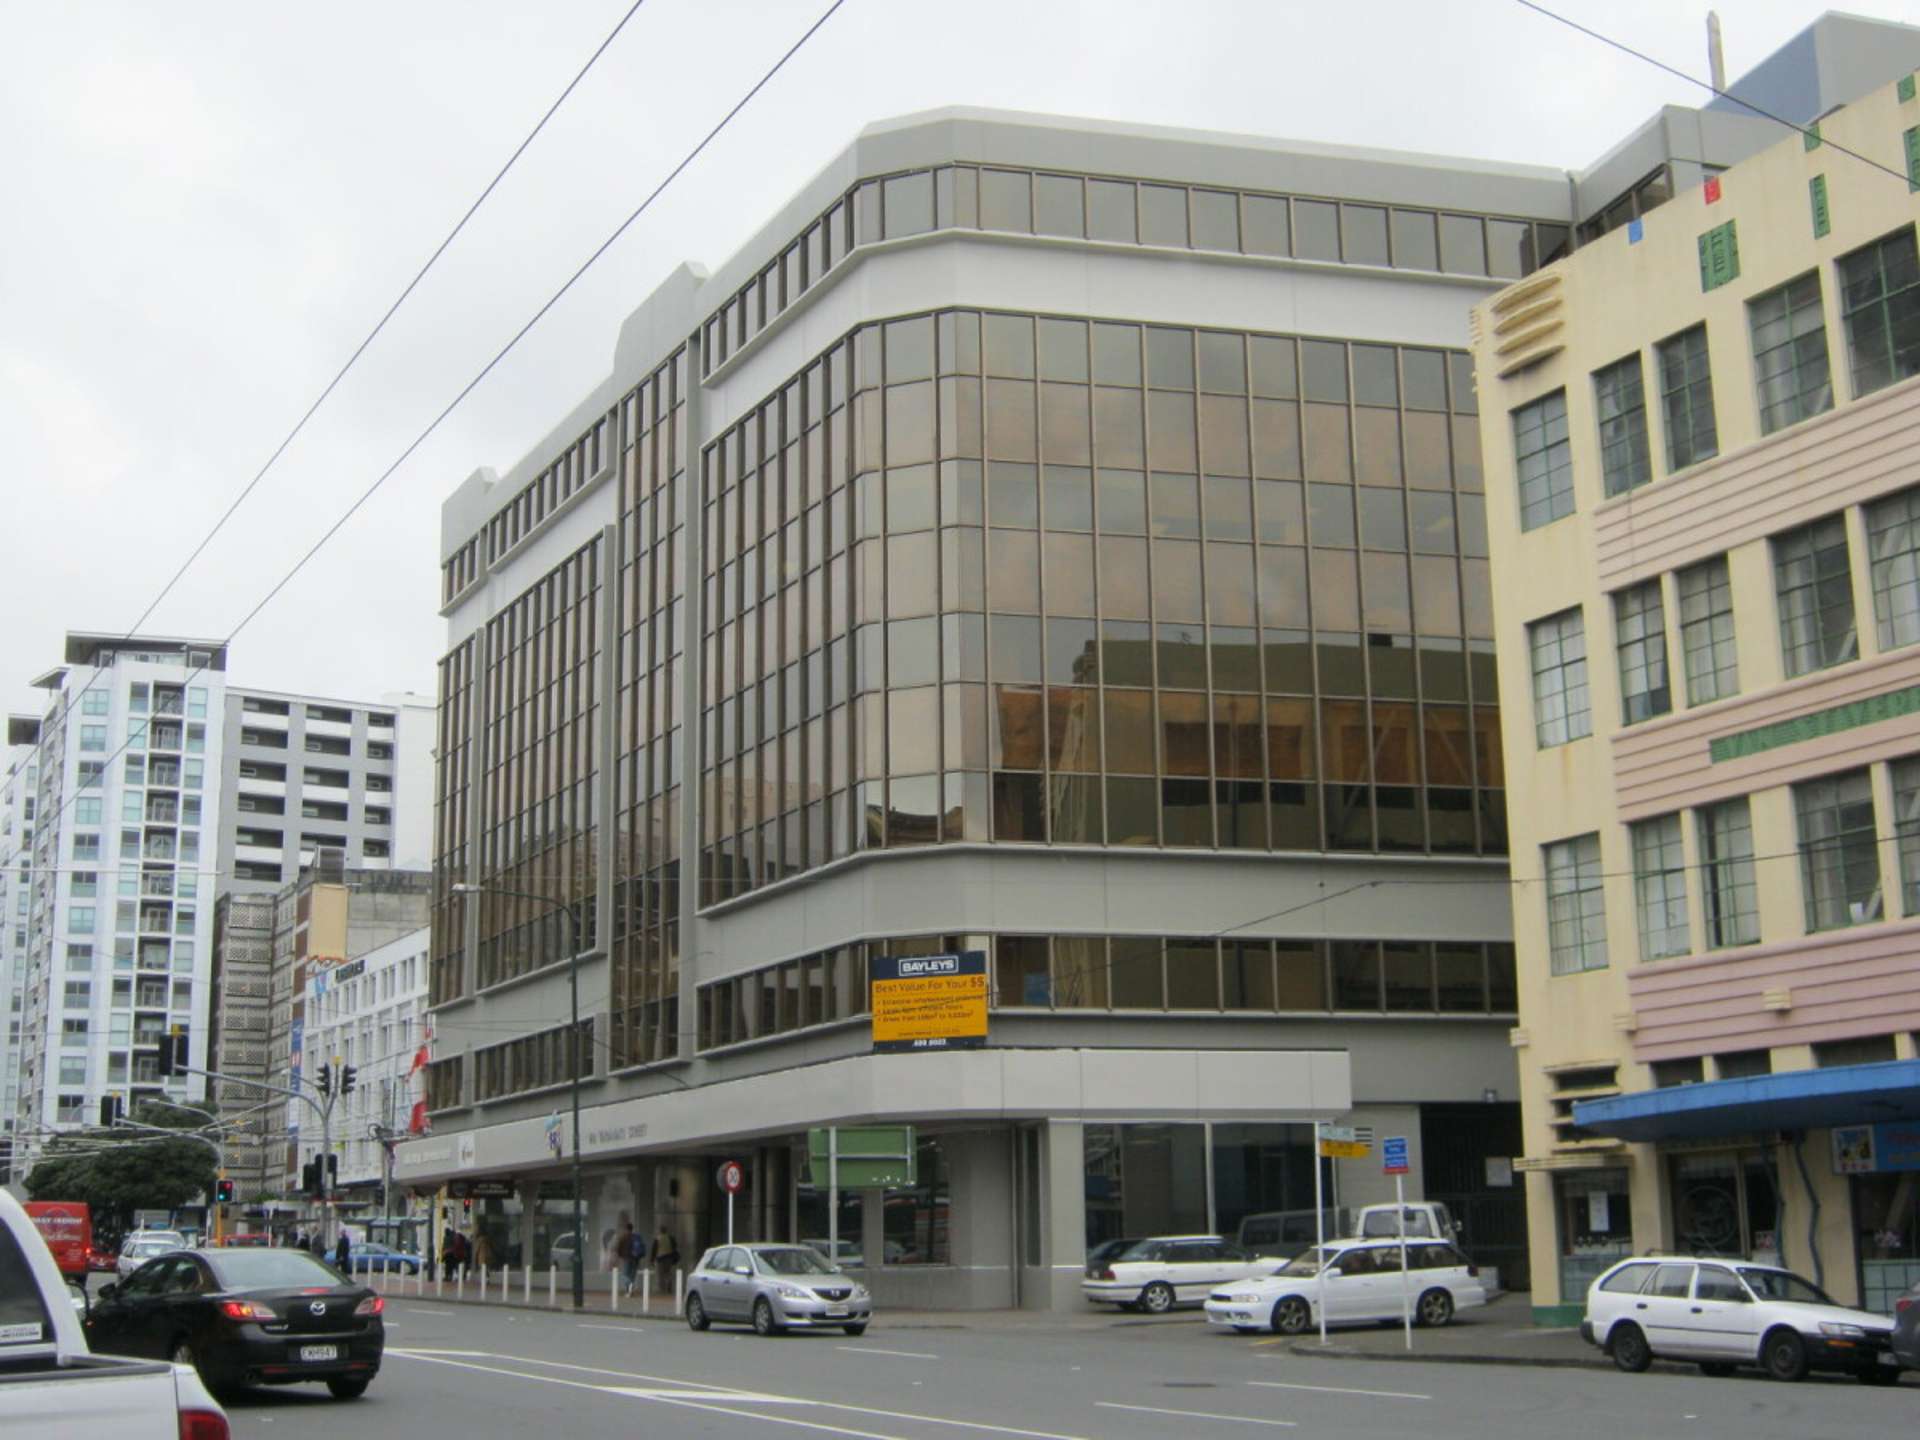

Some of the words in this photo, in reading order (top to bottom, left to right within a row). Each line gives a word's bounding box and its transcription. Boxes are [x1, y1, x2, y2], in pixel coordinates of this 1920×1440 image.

[903, 960, 954, 972] BAYLEYS
[875, 982, 897, 992] Best
[899, 981, 926, 992] Value
[927, 979, 945, 991] For
[946, 978, 967, 989] Your
